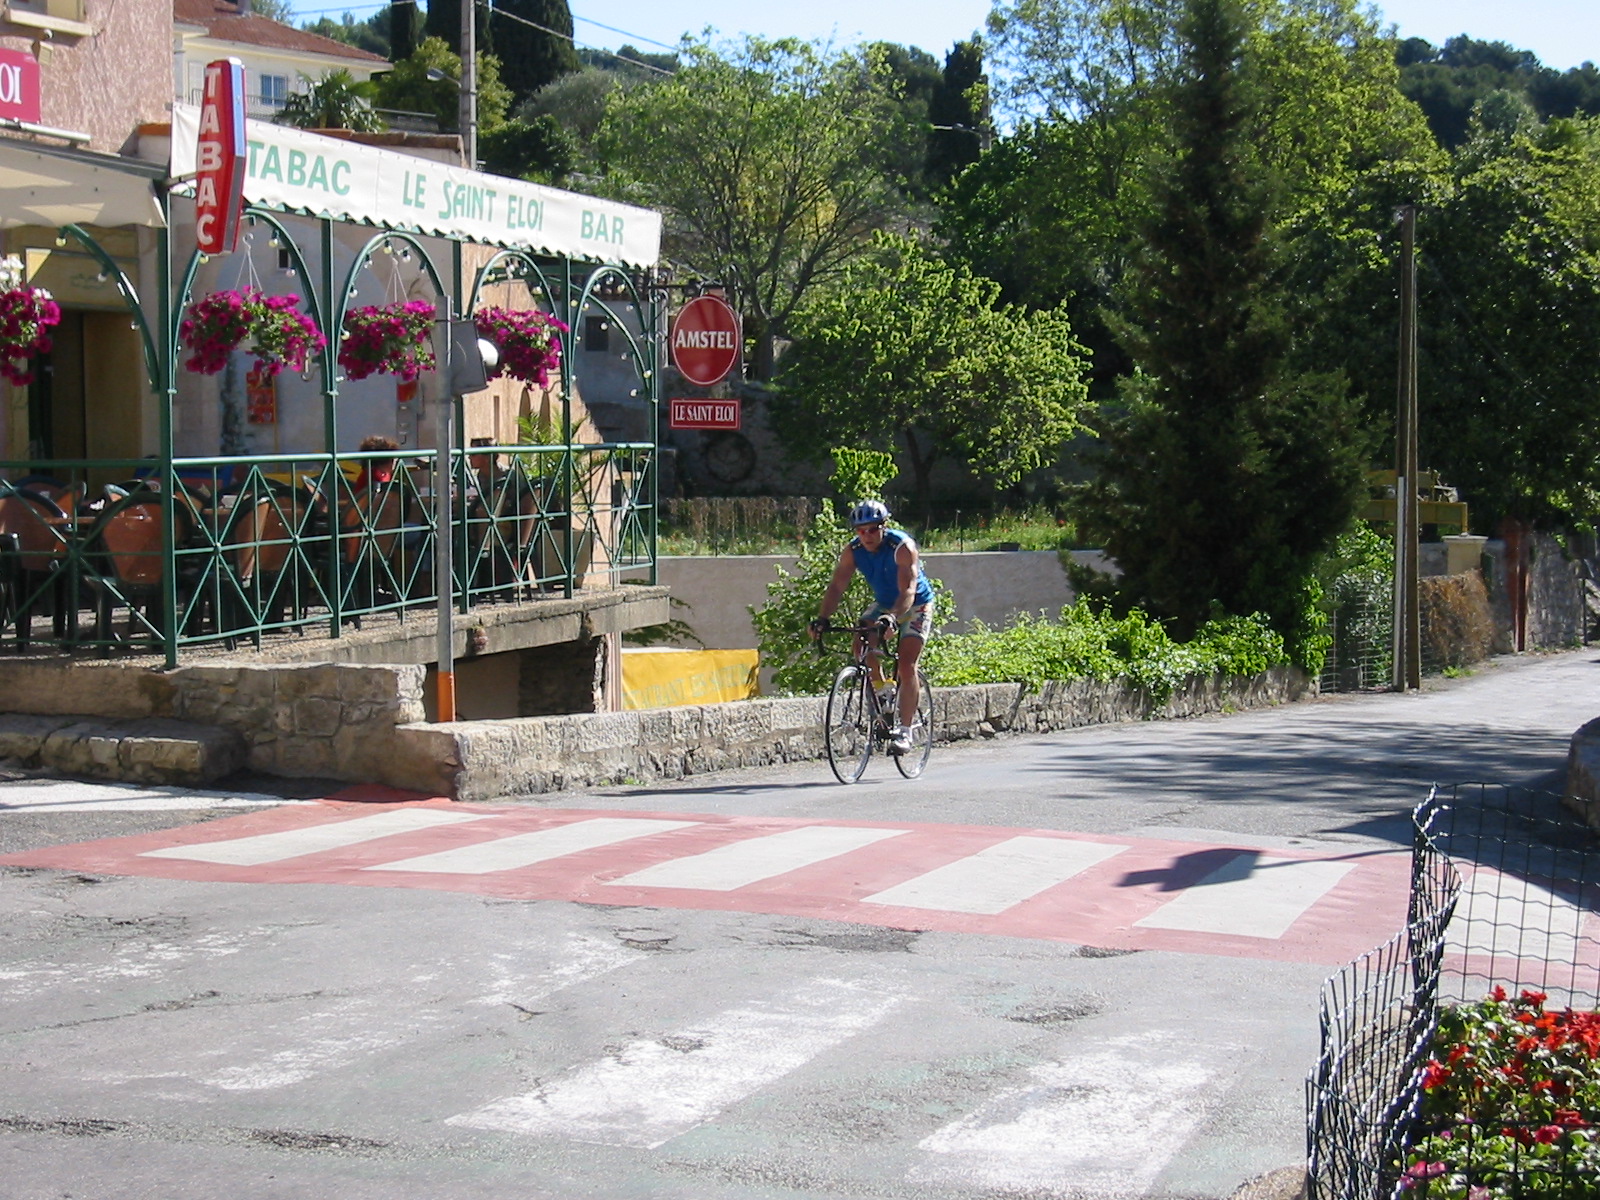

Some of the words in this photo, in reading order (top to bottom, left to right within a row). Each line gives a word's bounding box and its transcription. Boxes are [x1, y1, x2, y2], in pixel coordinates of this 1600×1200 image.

[196, 67, 223, 246] TABAC
[247, 139, 352, 197] TABAC
[402, 170, 427, 210] LE
[438, 180, 497, 222] SAINT
[506, 194, 545, 231] ELOI
[580, 210, 625, 245] BAR
[675, 329, 734, 349] AMSTEL
[675, 405, 686, 421] LE
[687, 405, 714, 422] SAINT
[715, 405, 735, 422] ELOI
